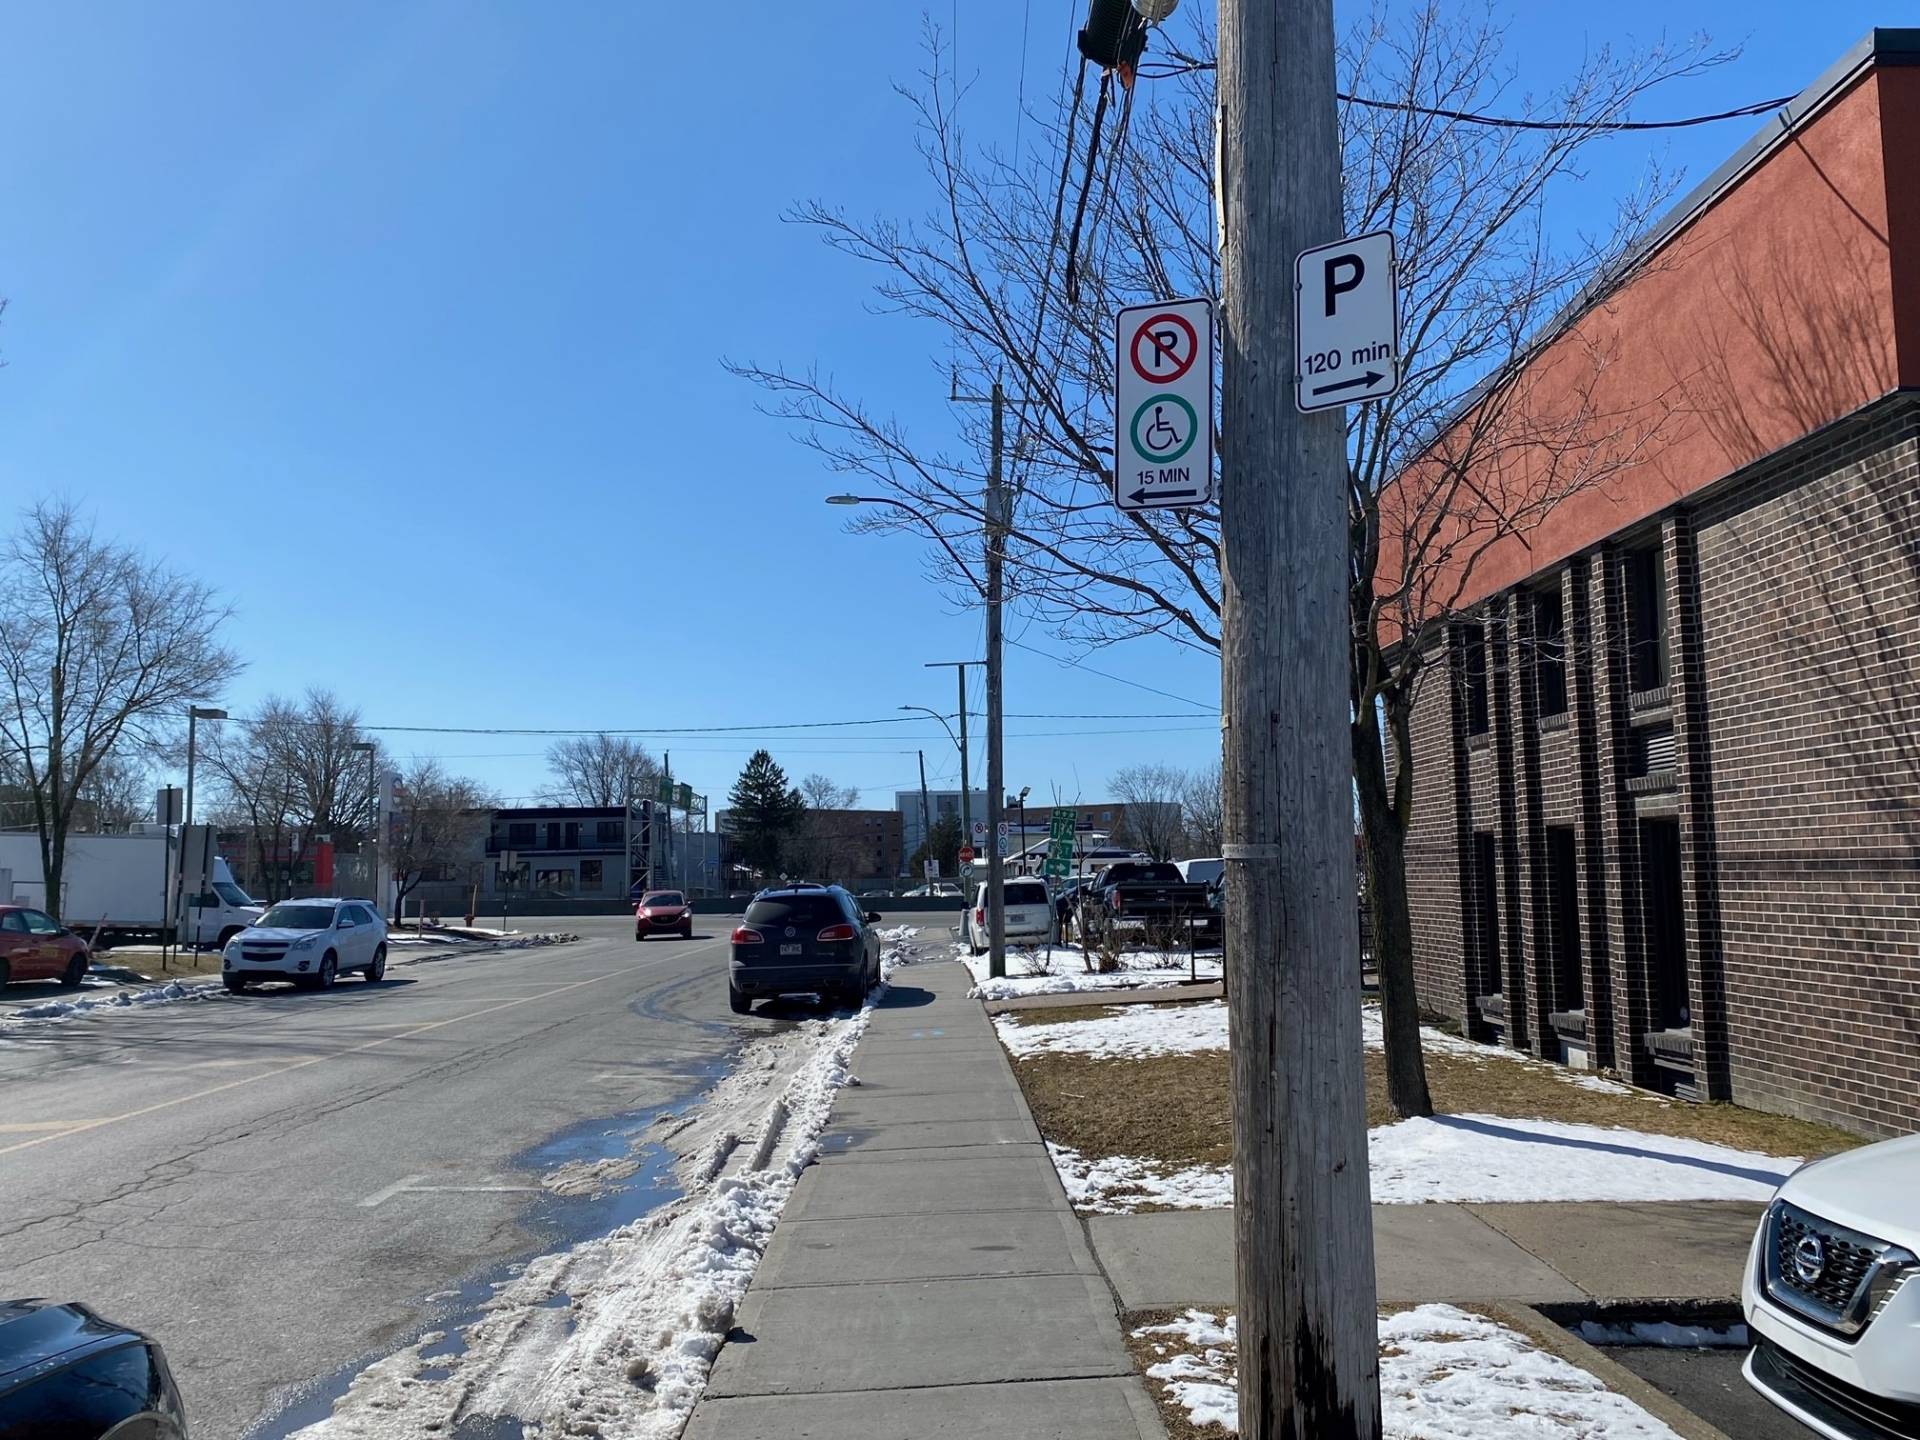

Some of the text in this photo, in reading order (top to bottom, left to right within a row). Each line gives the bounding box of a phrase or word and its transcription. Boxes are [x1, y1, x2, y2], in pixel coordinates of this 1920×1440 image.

[1324, 253, 1365, 317] P
[1154, 330, 1178, 368] P
[1304, 340, 1390, 375] 120 min
[1137, 467, 1190, 485] 15 MIN
